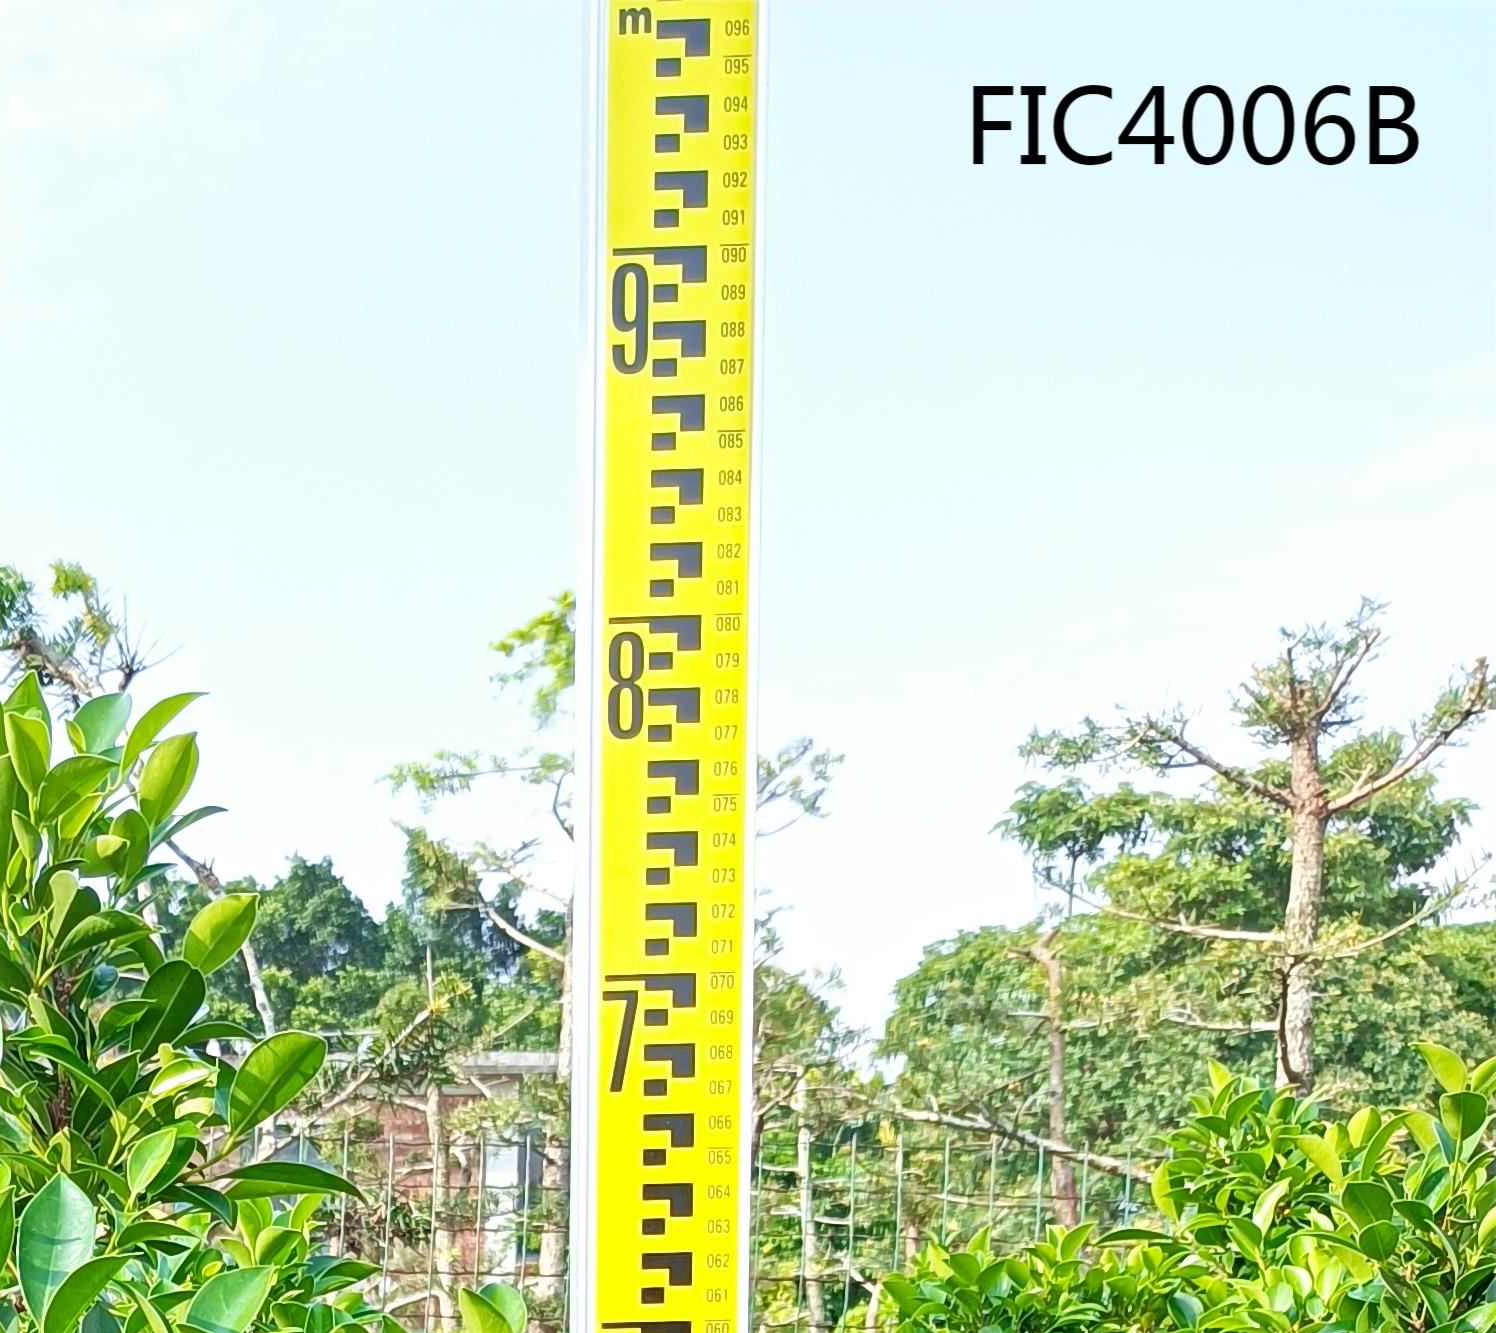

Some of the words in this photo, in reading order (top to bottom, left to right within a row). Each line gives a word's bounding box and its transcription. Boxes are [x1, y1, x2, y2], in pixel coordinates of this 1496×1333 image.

[619, 7, 651, 35] m
[724, 18, 750, 37] 096
[724, 57, 750, 75] 095
[723, 95, 749, 113] 094
[723, 133, 748, 151] 093
[722, 171, 748, 189] 092
[722, 209, 745, 226] 091
[721, 246, 747, 264] 090
[720, 283, 746, 301] 089
[612, 263, 648, 374] 9
[720, 320, 746, 338] 088
[719, 358, 745, 375] 087
[719, 394, 744, 413] 086
[718, 432, 744, 449] 085
[718, 469, 742, 486] 084
[717, 506, 742, 523] 083
[717, 542, 742, 560] 082
[716, 579, 739, 596] 081
[715, 616, 741, 632] 080
[715, 652, 740, 669] 079
[608, 631, 644, 739] 8
[714, 688, 739, 705] 078
[714, 724, 739, 741] 077
[713, 760, 738, 777] 076
[713, 796, 737, 813] 075
[712, 832, 737, 848] 074
[712, 867, 736, 884] 073
[711, 903, 736, 919] 072
[711, 939, 733, 955] 071
[710, 974, 735, 990] 070
[710, 1009, 734, 1025] 069
[603, 990, 638, 1092] 7
[709, 1044, 733, 1060] 068
[709, 1079, 733, 1095] 067
[708, 1114, 732, 1130] 066
[708, 1149, 732, 1165] 065
[707, 1184, 731, 1200] 064
[707, 1218, 730, 1234] 063
[706, 1253, 730, 1269] 062
[706, 1287, 728, 1303] 061
